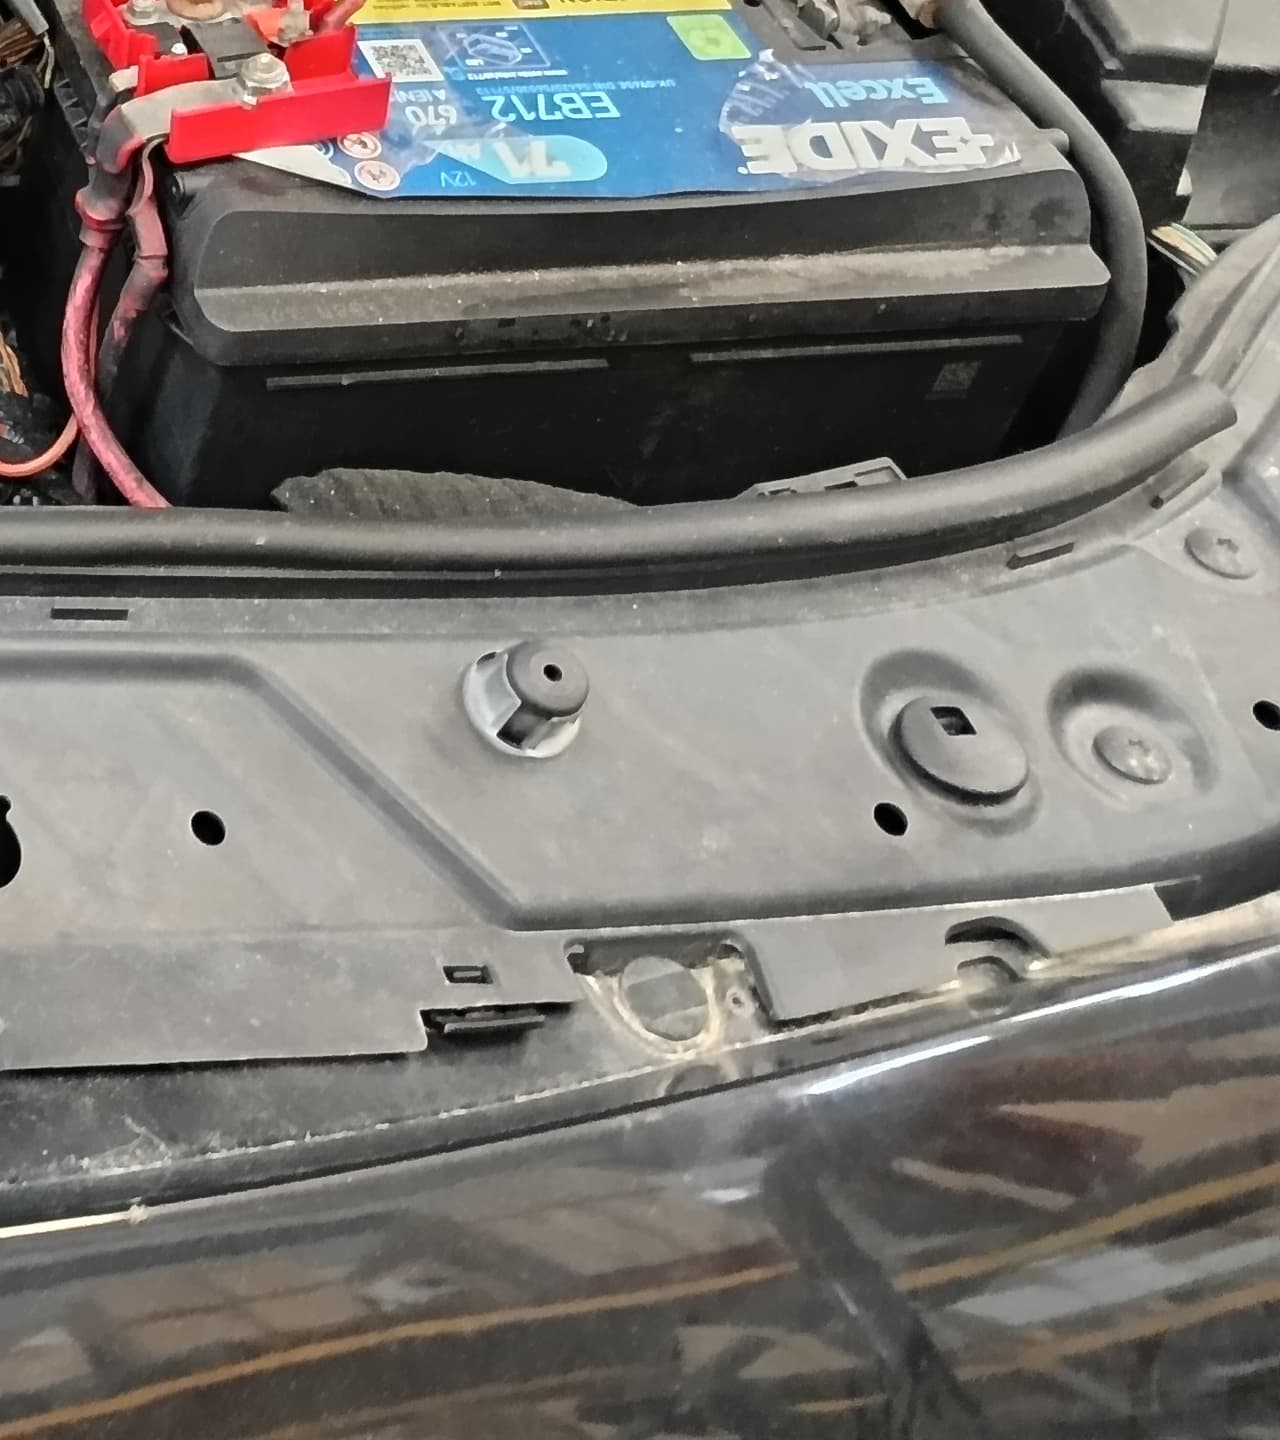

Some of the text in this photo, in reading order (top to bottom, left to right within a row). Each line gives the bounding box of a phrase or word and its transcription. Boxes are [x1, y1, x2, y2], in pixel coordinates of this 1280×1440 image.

[481, 91, 621, 122] EB712
[804, 76, 948, 108] Excell
[404, 104, 457, 126] 670
[493, 140, 572, 178] 71
[731, 116, 994, 175] EXIDE
[439, 170, 477, 188] 12V
